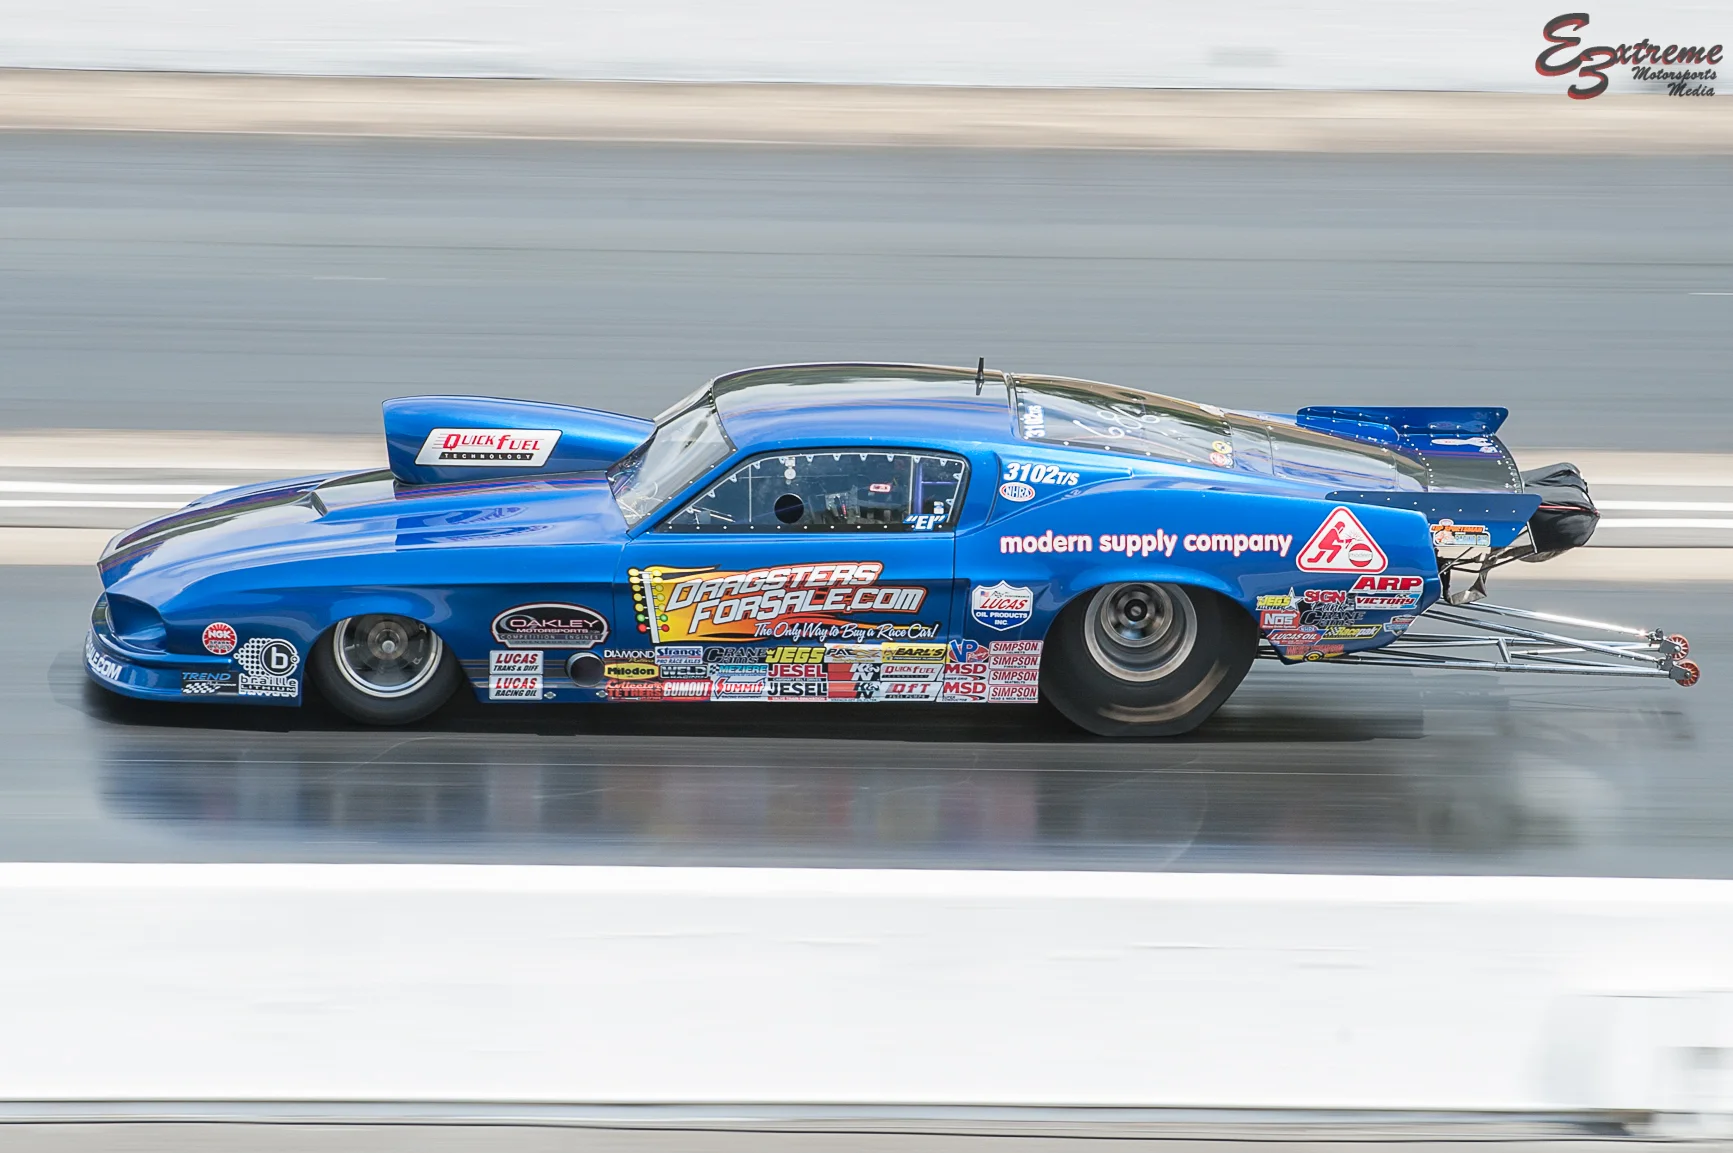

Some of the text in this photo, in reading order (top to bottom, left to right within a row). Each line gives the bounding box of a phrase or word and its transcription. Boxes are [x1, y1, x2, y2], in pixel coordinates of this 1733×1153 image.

[1004, 486, 1031, 498] NHRA
[1000, 529, 1293, 558] modern supply company
[664, 564, 882, 612] DRAGSTERS
[1354, 577, 1422, 590] ARP
[1305, 591, 1346, 603] SIGN
[980, 598, 1028, 610] LUCAS
[510, 619, 599, 628] OAKLEY
[1264, 613, 1298, 625] NOS
[208, 630, 231, 638] NGK
[754, 622, 939, 642] The Only Way to Buy a Race Car!
[656, 647, 702, 656] Strange
[895, 648, 944, 656] EARL'S
[950, 640, 981, 663] VP
[993, 642, 1039, 651] SIMPSON
[271, 647, 288, 669] b
[496, 654, 538, 664] LUCAS
[604, 649, 656, 658] DIAMOND
[765, 647, 827, 663] JEGS
[992, 656, 1038, 666] SIMPSON
[607, 667, 655, 675] Milodon
[662, 666, 707, 675] WELD
[720, 665, 767, 673] MEZIERE
[768, 664, 827, 677] JESEL
[944, 663, 987, 674] MSD
[182, 673, 232, 681] TREND
[241, 675, 297, 685] braille
[992, 671, 1038, 681] SIMPSON
[495, 678, 537, 689] LUCAS
[944, 682, 987, 694] MSD
[495, 689, 524, 697] RACING
[663, 682, 709, 697] GUMOUT
[767, 683, 827, 696] JESEL
[991, 687, 1037, 697] SIMPSON
